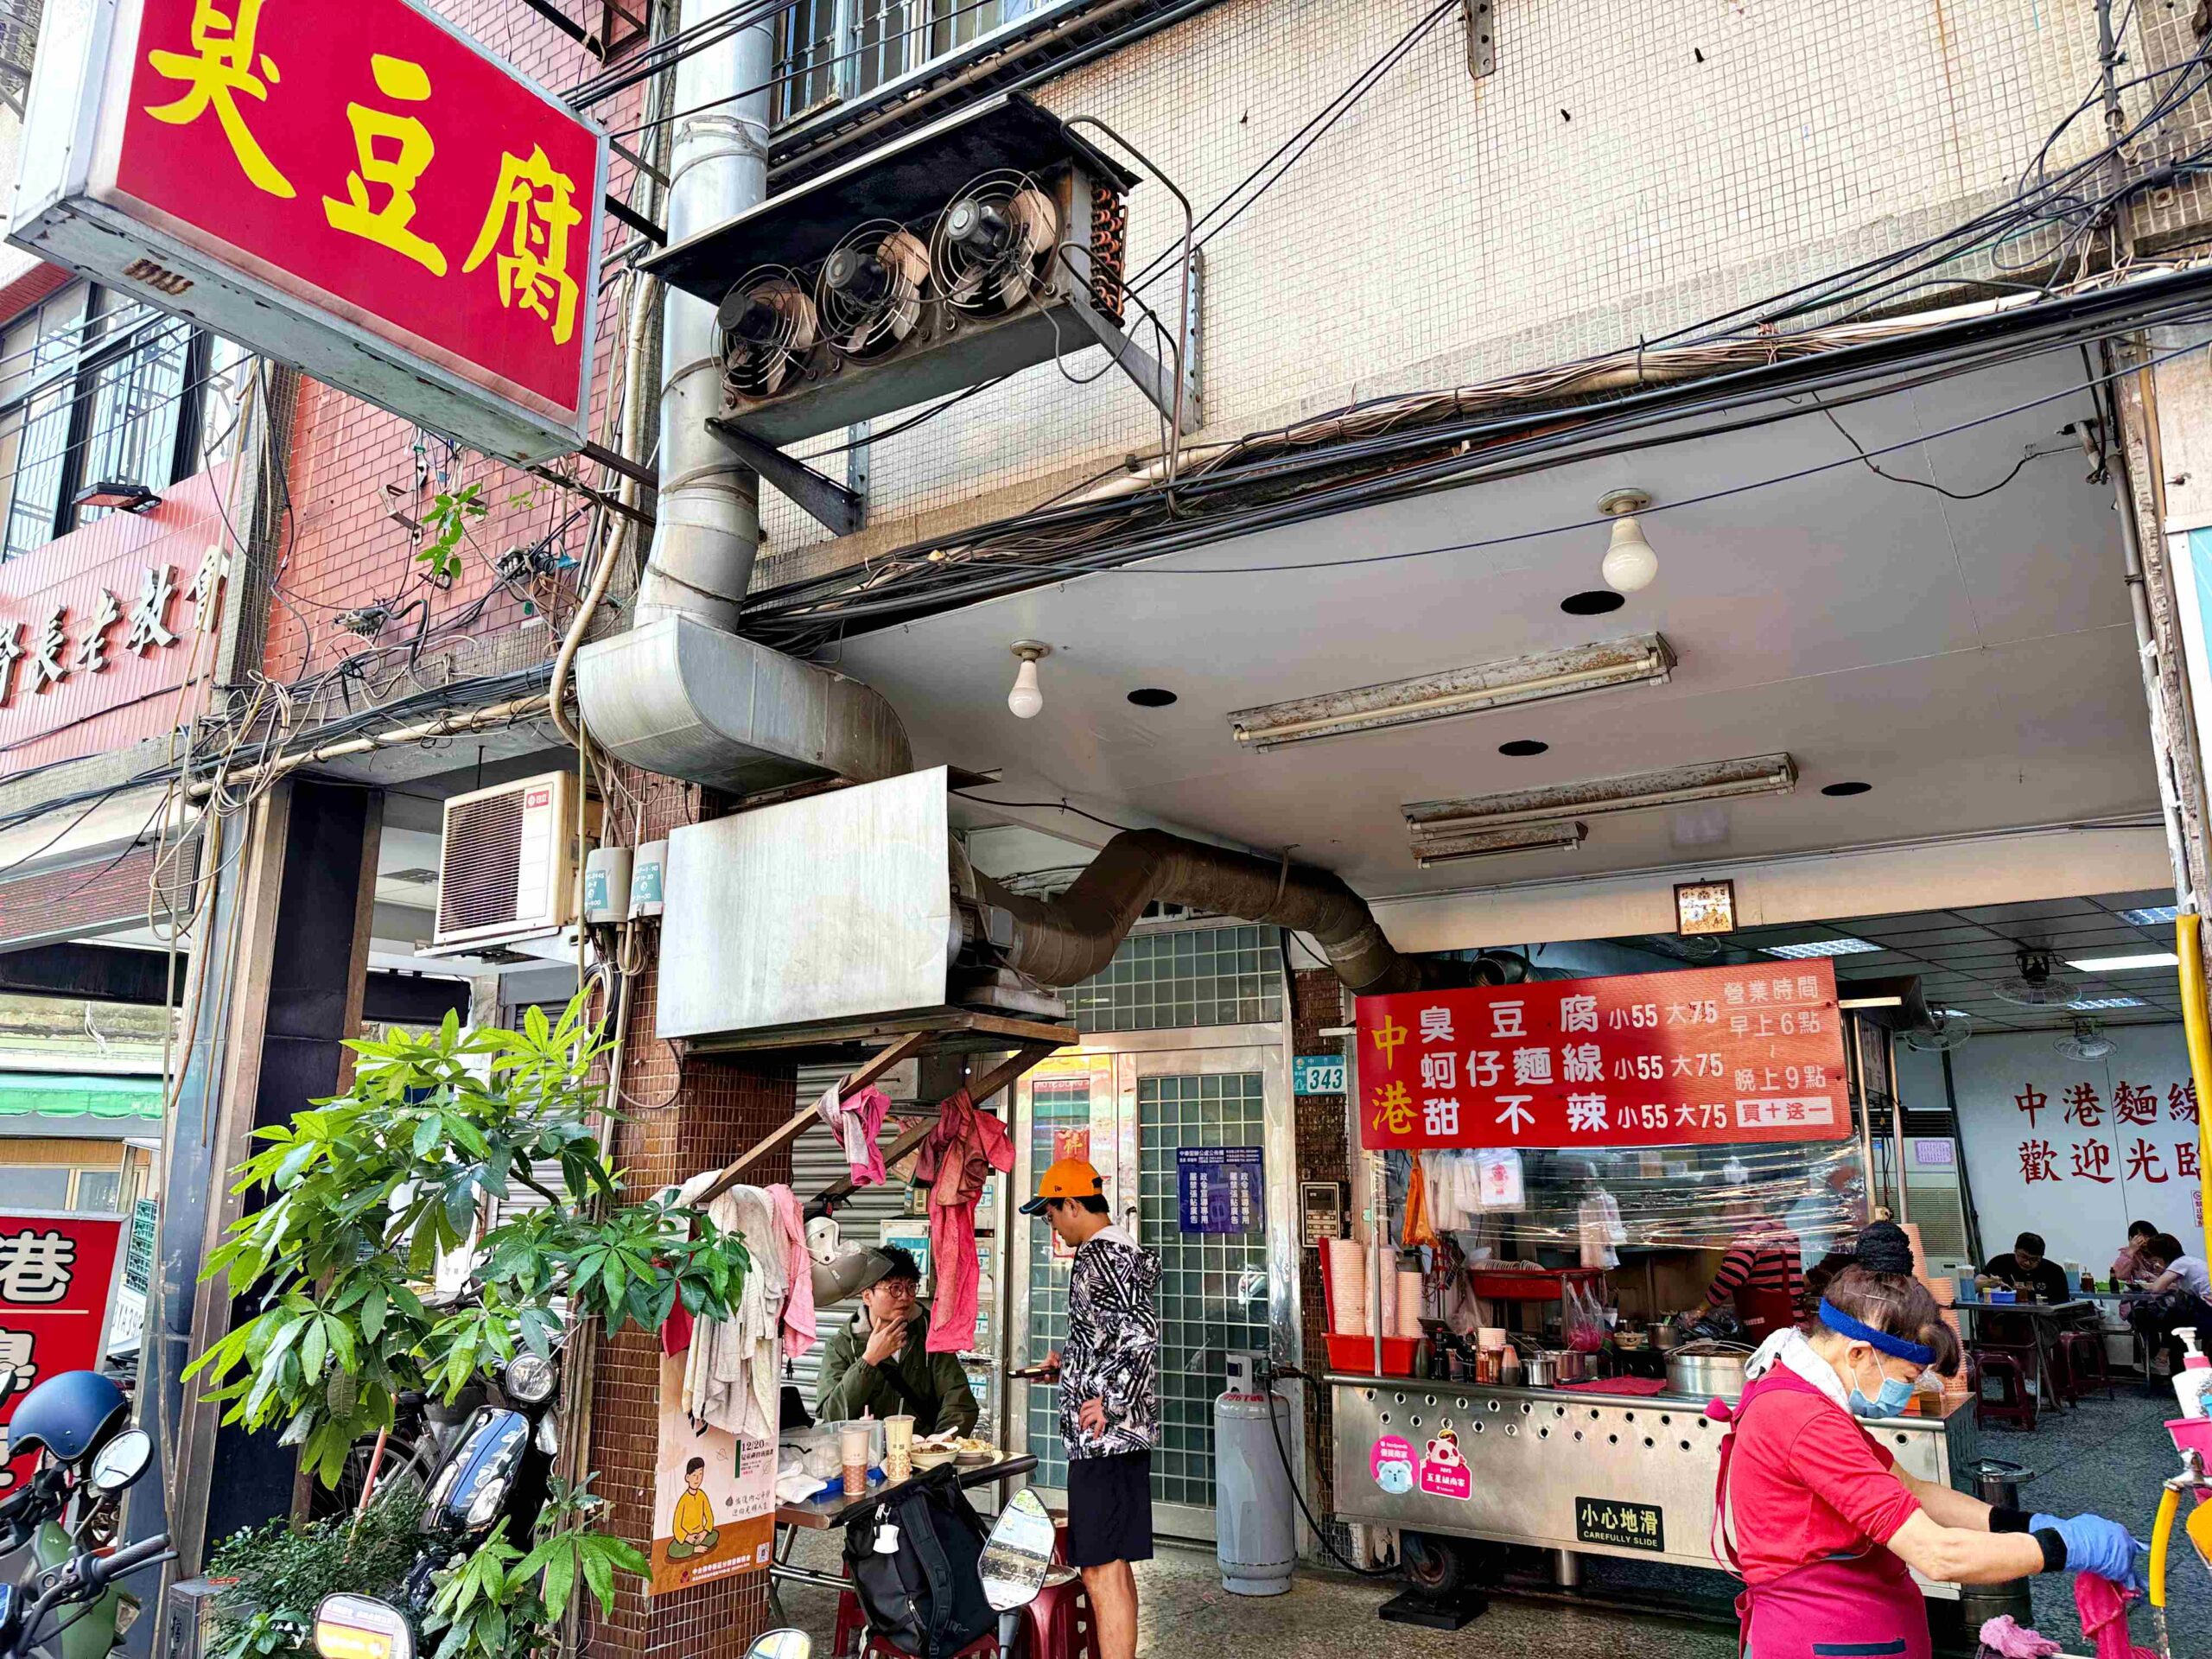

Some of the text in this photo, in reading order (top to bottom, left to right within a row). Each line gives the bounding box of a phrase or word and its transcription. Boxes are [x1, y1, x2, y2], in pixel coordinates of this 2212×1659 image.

[143, 0, 583, 346] 臭豆腐
[1724, 975, 1820, 1005] 營業時間
[1419, 994, 1719, 1042] 臭豆腐 小55 大75
[1730, 1011, 1821, 1038] 早上6點
[1309, 1068, 1344, 1090] 343
[1371, 1014, 1418, 1135] 中港
[1421, 1042, 1724, 1090] 蚵仔麵線 小55 大75
[1734, 1065, 1827, 1092] 晚上9點
[1423, 1091, 1727, 1136] 甜不辣 小55 大75
[1743, 1102, 1827, 1122] 買十送一
[2014, 1077, 2201, 1129] 中港麵線
[742, 1440, 765, 1452] 12/20
[1581, 1503, 1659, 1536] 小心地滑
[1583, 1529, 1658, 1548] CAREFULLY SLIDE
